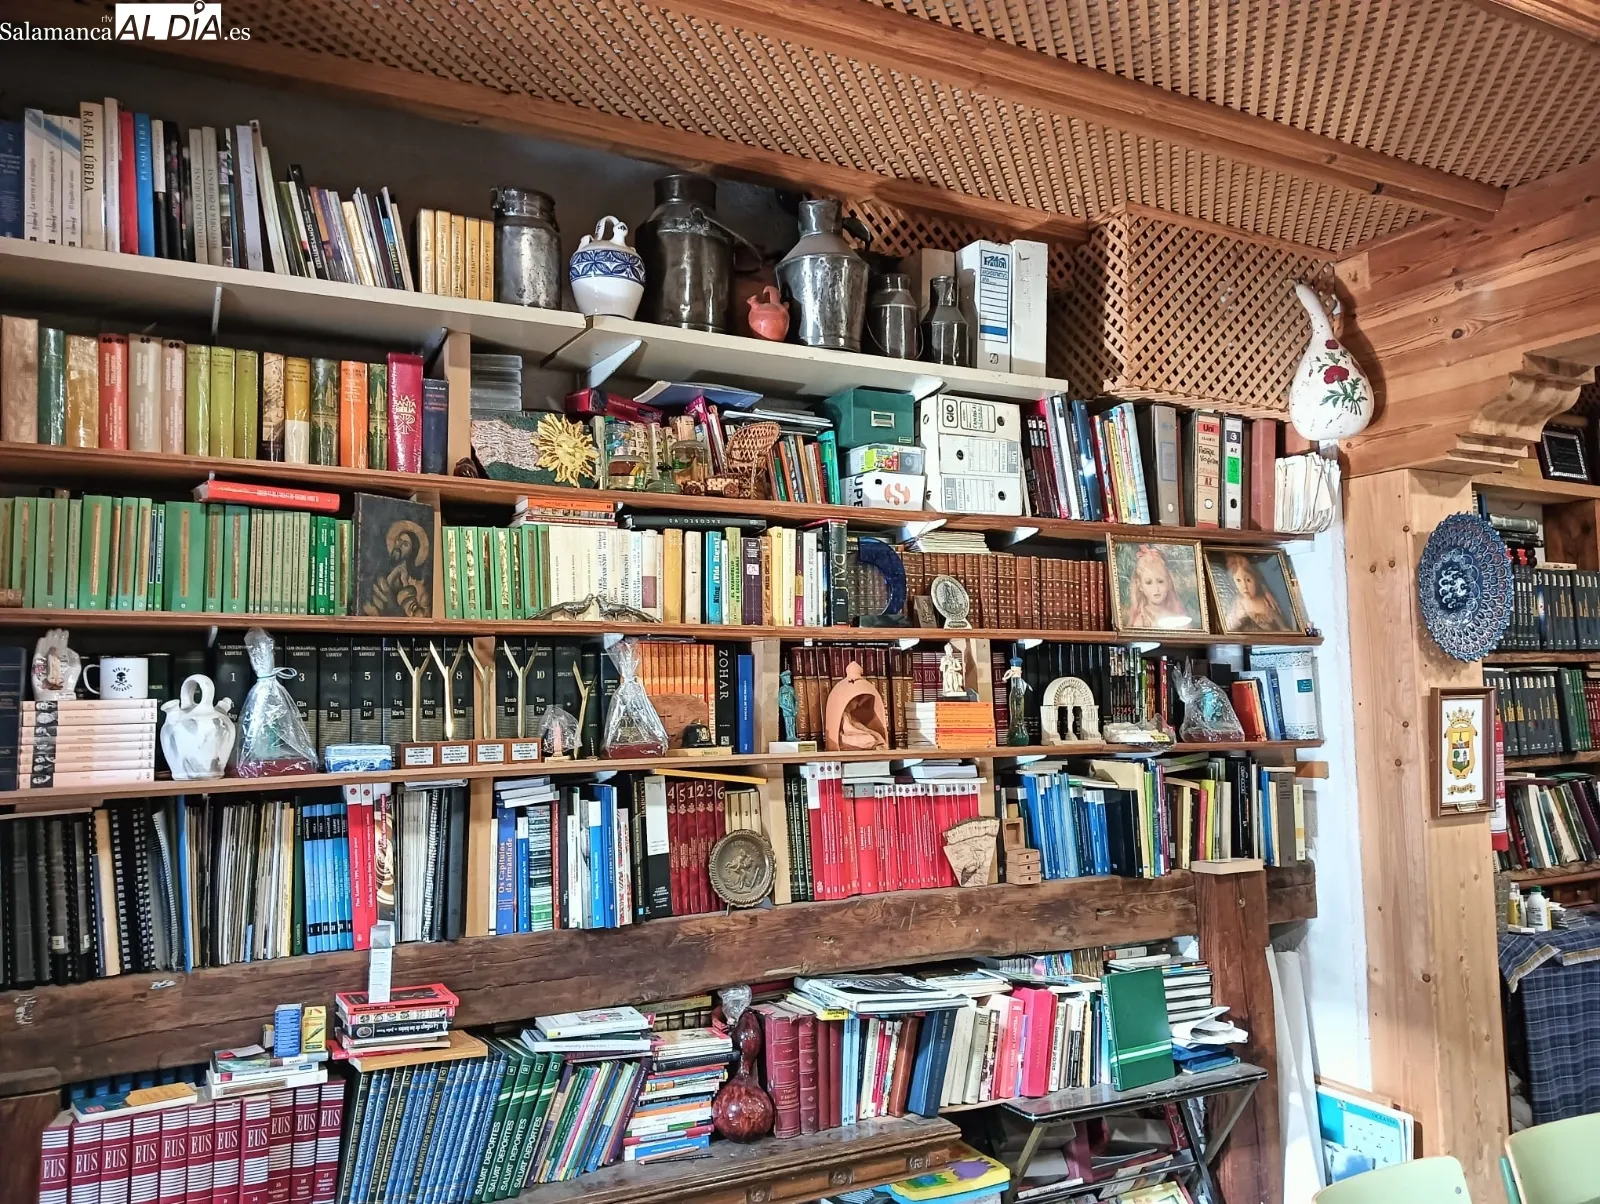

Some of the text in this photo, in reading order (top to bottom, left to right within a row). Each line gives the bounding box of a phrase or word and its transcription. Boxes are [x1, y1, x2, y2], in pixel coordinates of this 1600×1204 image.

[83, 110, 95, 192] RAFAEL ÚBEDA
[194, 212, 204, 249] HISTORIA
[208, 213, 217, 250] HISTORIA
[946, 405, 954, 422] GIO
[1203, 424, 1214, 432] Uni
[833, 553, 848, 593] DALÍ
[231, 672, 236, 682] 1
[298, 673, 305, 682] 3
[331, 673, 338, 682] 4
[364, 672, 371, 680] 5
[395, 672, 402, 681] 6
[426, 672, 432, 680] 7
[456, 671, 462, 680] 8
[506, 671, 513, 680] 9
[536, 671, 545, 679] 10
[718, 649, 728, 700] ZOHAR
[667, 787, 675, 799] 4
[679, 788, 686, 802] 5
[688, 786, 695, 798] 1
[696, 785, 704, 797] 2
[706, 784, 713, 798] 3
[717, 786, 725, 800] 6
[499, 881, 505, 893] Os
[506, 882, 512, 893] da
[397, 1094, 406, 1119] ANIMAL
[427, 1115, 435, 1134] REINO
[432, 1091, 441, 1114] ANIMAL
[271, 1115, 291, 1135] EUS
[296, 1113, 316, 1132] EUS
[321, 1109, 340, 1128] EUS
[382, 1122, 390, 1140] REINO
[387, 1096, 396, 1120] ANIMAL
[190, 1133, 212, 1154] EUS
[217, 1129, 238, 1150] EUS
[247, 1127, 268, 1148] EUS
[104, 1147, 127, 1169] EUS
[135, 1143, 157, 1164] EUS
[164, 1138, 186, 1159] EUS
[475, 1121, 500, 1195] SALVAT DEPORTES
[488, 1120, 514, 1193] SALVAT DEPORTES
[501, 1118, 527, 1191] SALVAT DEPORTES
[514, 1116, 542, 1188] SALVAT DEPORTES
[43, 1157, 66, 1178] EUS
[75, 1152, 98, 1173] EUS
